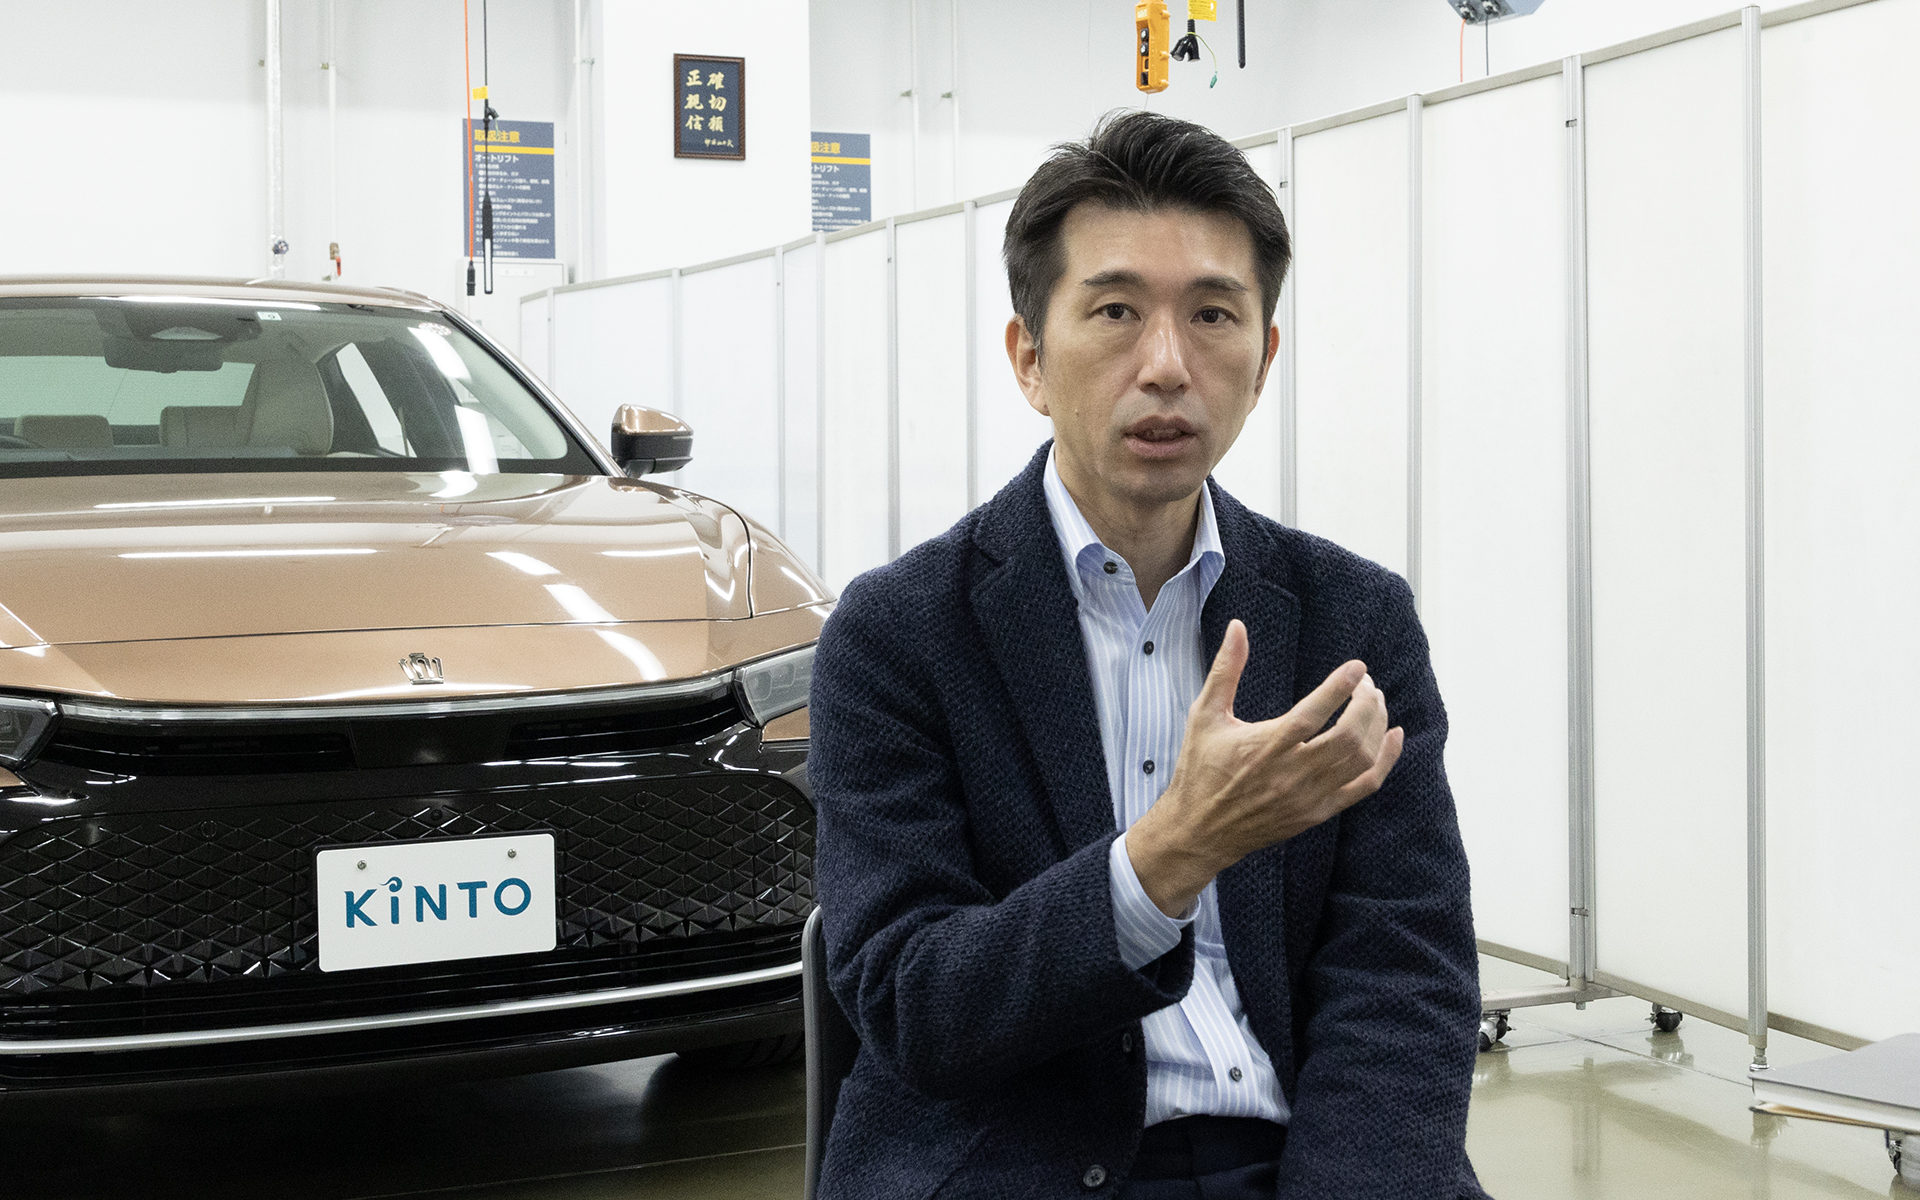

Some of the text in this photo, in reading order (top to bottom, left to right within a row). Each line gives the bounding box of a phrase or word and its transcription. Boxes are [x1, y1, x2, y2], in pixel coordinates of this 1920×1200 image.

[685, 69, 725, 91] 正確
[474, 153, 520, 163] オートリフト
[811, 164, 840, 173] トリフト
